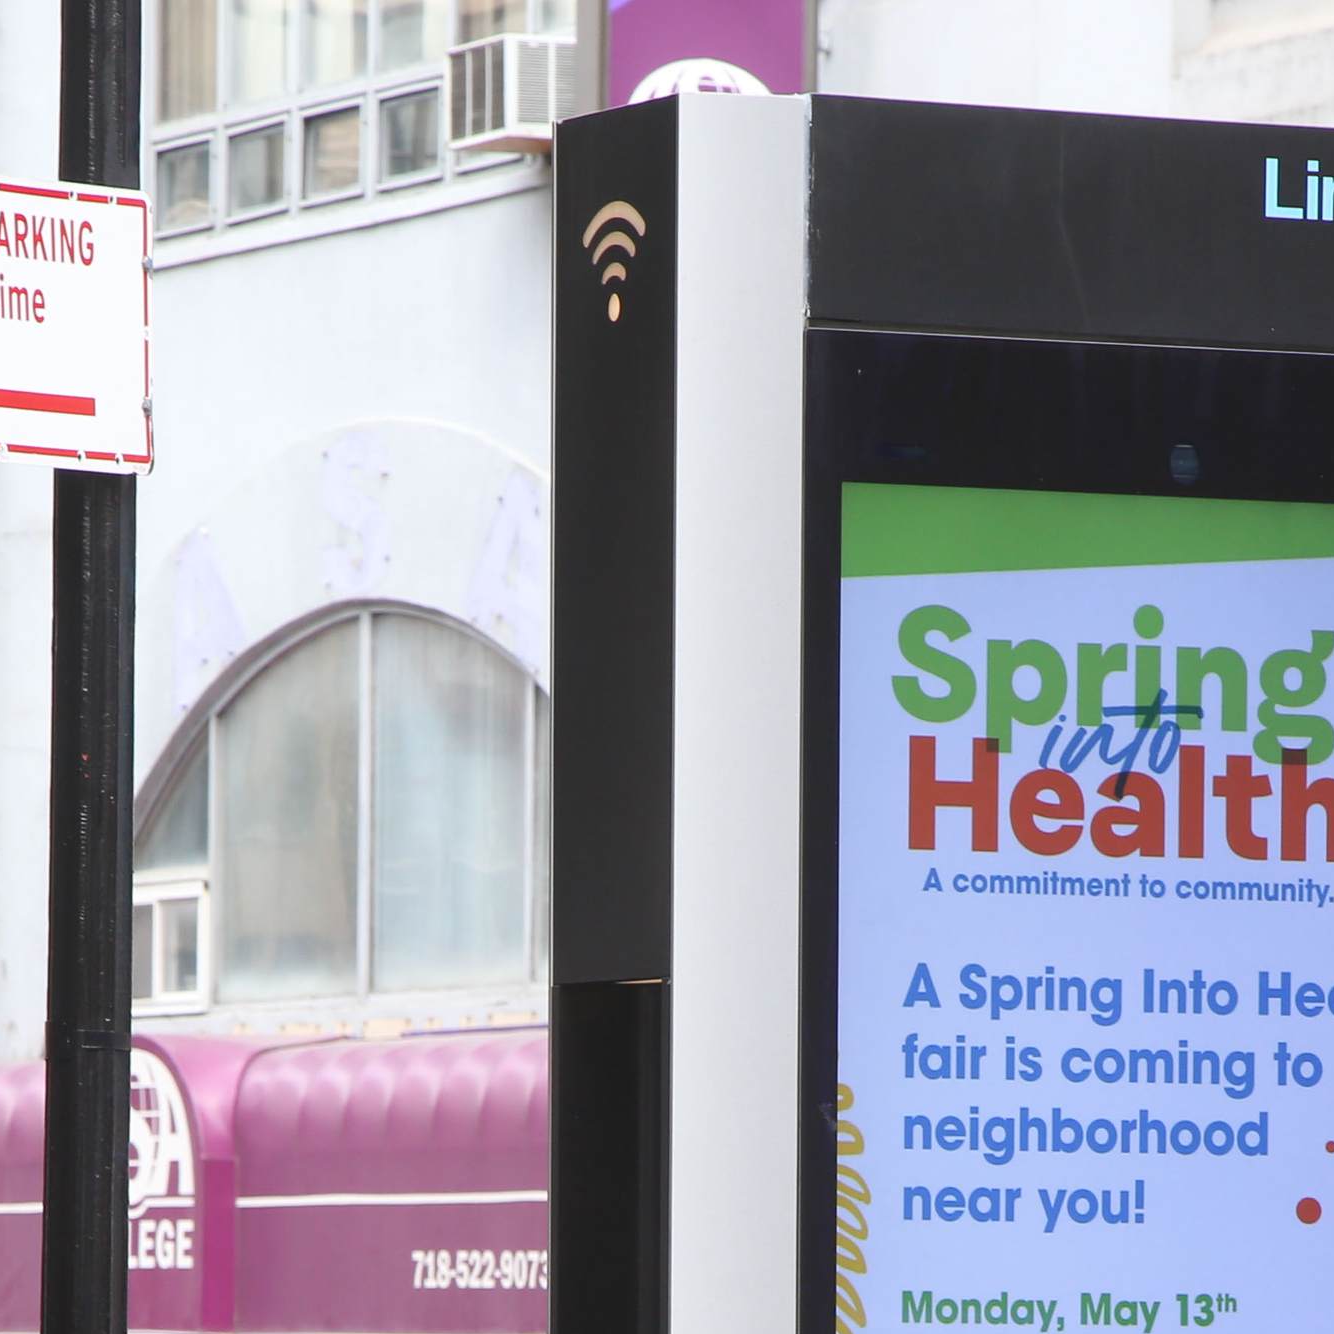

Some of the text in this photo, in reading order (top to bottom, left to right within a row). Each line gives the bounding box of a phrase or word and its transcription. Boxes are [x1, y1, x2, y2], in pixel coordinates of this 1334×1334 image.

[1038, 688, 1203, 800] into
[923, 867, 1334, 908] A commitment to community.
[902, 963, 941, 1008] A
[959, 964, 1122, 1026] Spring
[1143, 969, 1238, 1015] Into
[902, 1034, 987, 1079] fair
[1005, 1036, 1042, 1082] is
[1061, 1040, 1256, 1098] coming
[1274, 1043, 1322, 1087] to
[903, 1107, 1268, 1165] neighborhood
[903, 1180, 1145, 1233] near you!
[129, 1219, 194, 1270] LEGE
[901, 1290, 1237, 1333] Monday, May 13th
